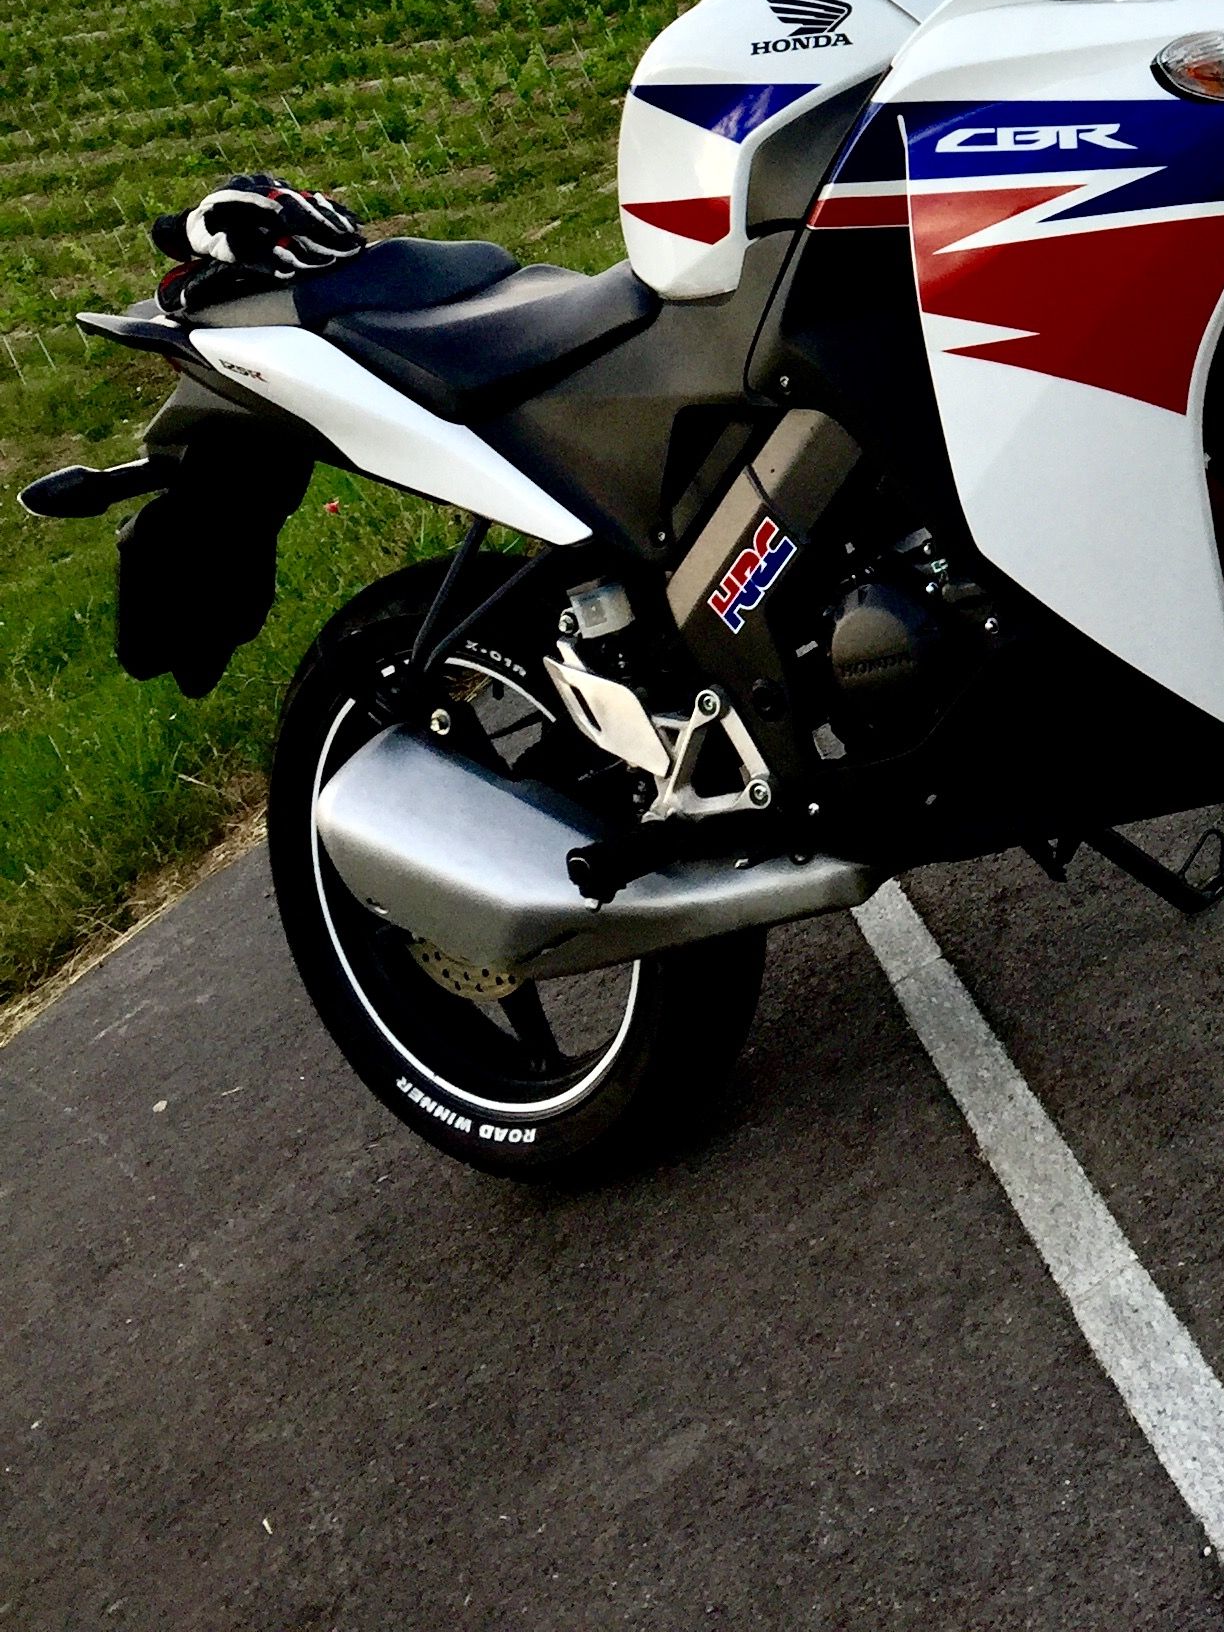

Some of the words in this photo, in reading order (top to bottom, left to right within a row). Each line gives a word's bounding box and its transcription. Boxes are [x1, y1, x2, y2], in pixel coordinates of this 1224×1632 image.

[751, 33, 853, 55] HONDA
[935, 123, 1138, 153] CBR
[707, 516, 797, 634] HRC
[396, 1076, 472, 1133] WINNER
[478, 1124, 536, 1143] ROAD
